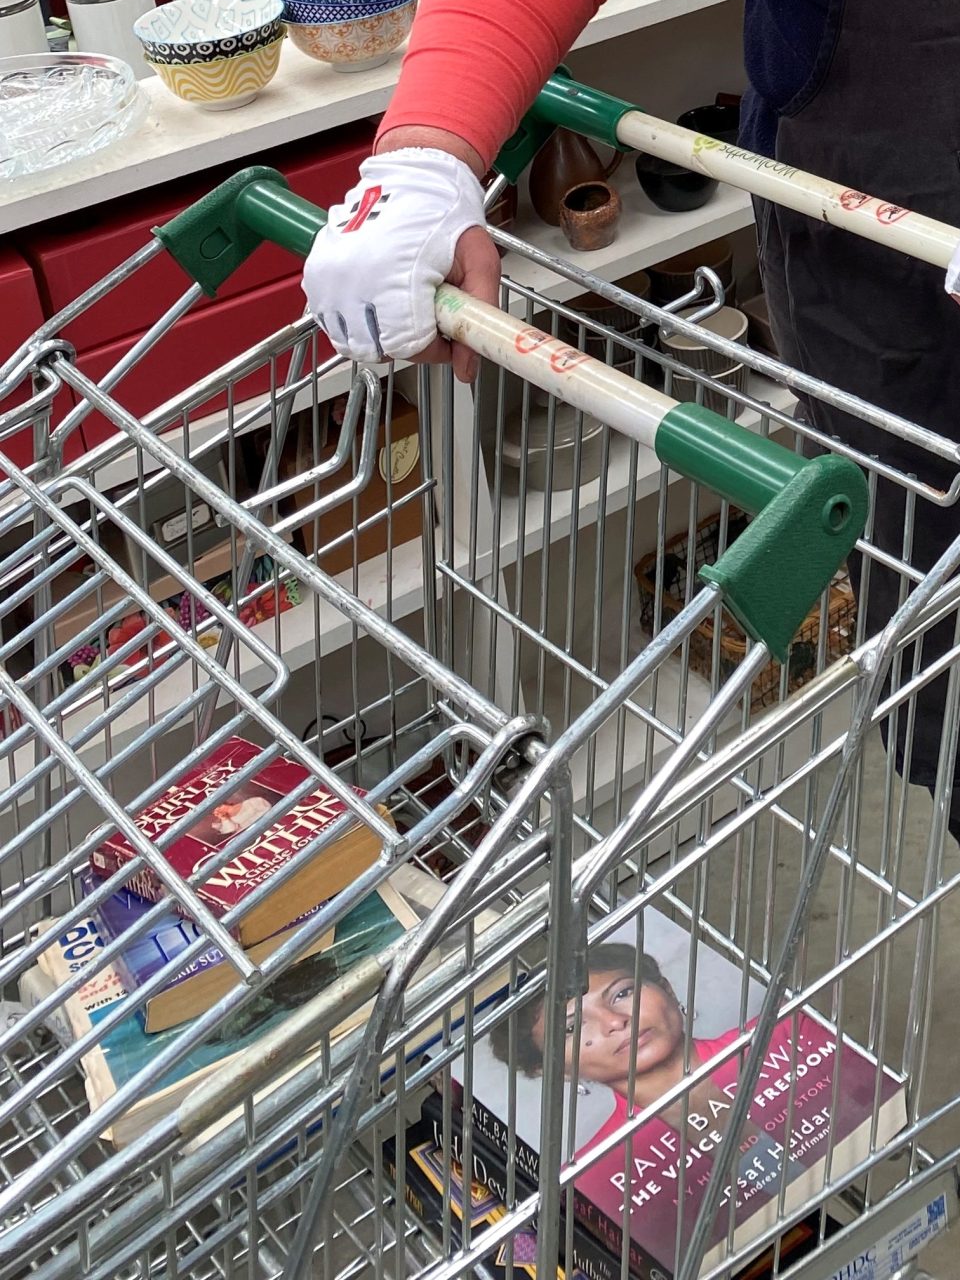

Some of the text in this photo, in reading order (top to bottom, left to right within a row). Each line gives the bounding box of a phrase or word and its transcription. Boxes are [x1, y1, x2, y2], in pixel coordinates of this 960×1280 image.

[134, 759, 238, 833] SHIRLEY
[794, 1075, 832, 1109] STORY
[618, 1180, 662, 1214] HE
[661, 1129, 723, 1180] VOICE
[754, 1040, 837, 1108] FREEDOM
[719, 1156, 765, 1207] nsaf
[767, 1106, 832, 1160] Haidar
[609, 1131, 677, 1193] RAIF
[743, 1171, 778, 1201] Andrea
